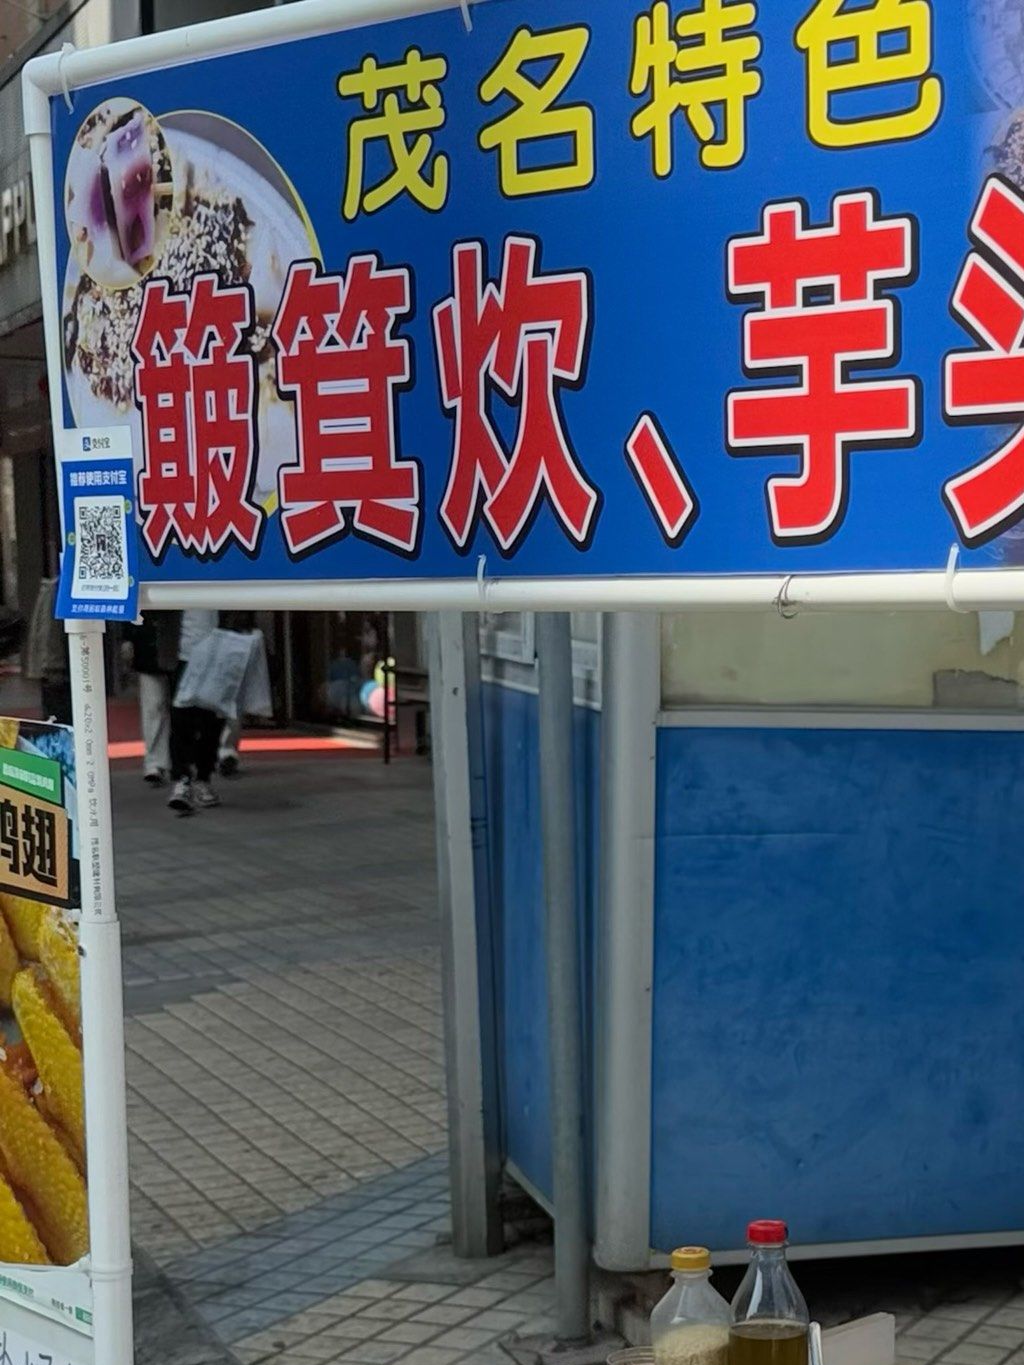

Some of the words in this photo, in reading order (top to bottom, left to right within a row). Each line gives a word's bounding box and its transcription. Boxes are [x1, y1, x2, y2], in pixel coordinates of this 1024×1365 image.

[338, 0, 942, 221] 茂名特色
[69, 470, 127, 488] 推荐使用支付宝
